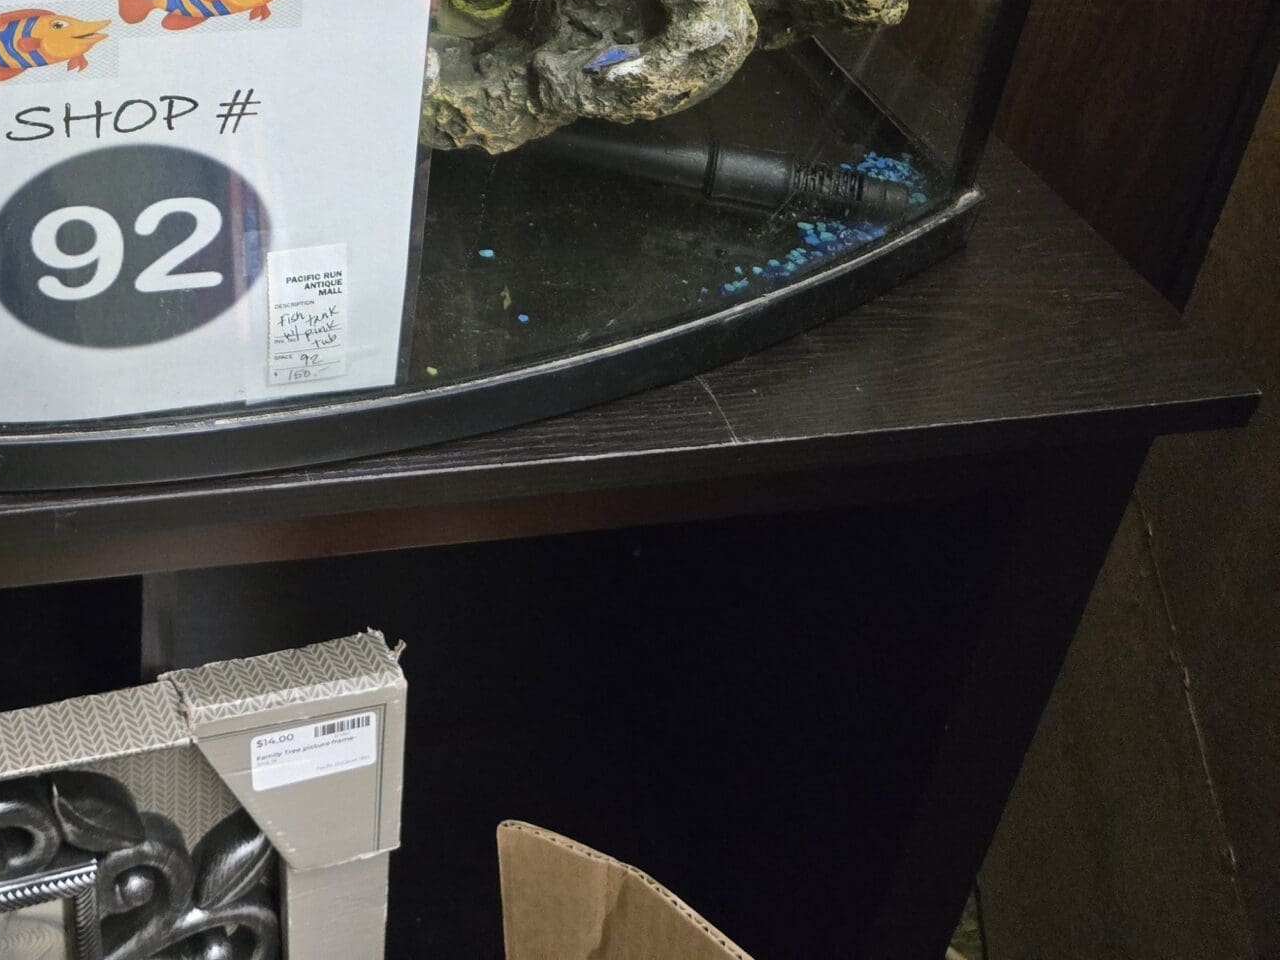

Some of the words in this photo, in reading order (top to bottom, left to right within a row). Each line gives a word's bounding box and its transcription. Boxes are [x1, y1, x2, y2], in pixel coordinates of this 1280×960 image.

[5, 95, 199, 141] SHOP
[216, 88, 261, 134] #
[30, 197, 224, 301] 92
[286, 273, 321, 284] PACIFIC
[323, 271, 343, 279] RUN
[304, 279, 343, 290] ANTIQUE
[318, 287, 343, 296] MALL
[256, 733, 295, 749] $14.00
